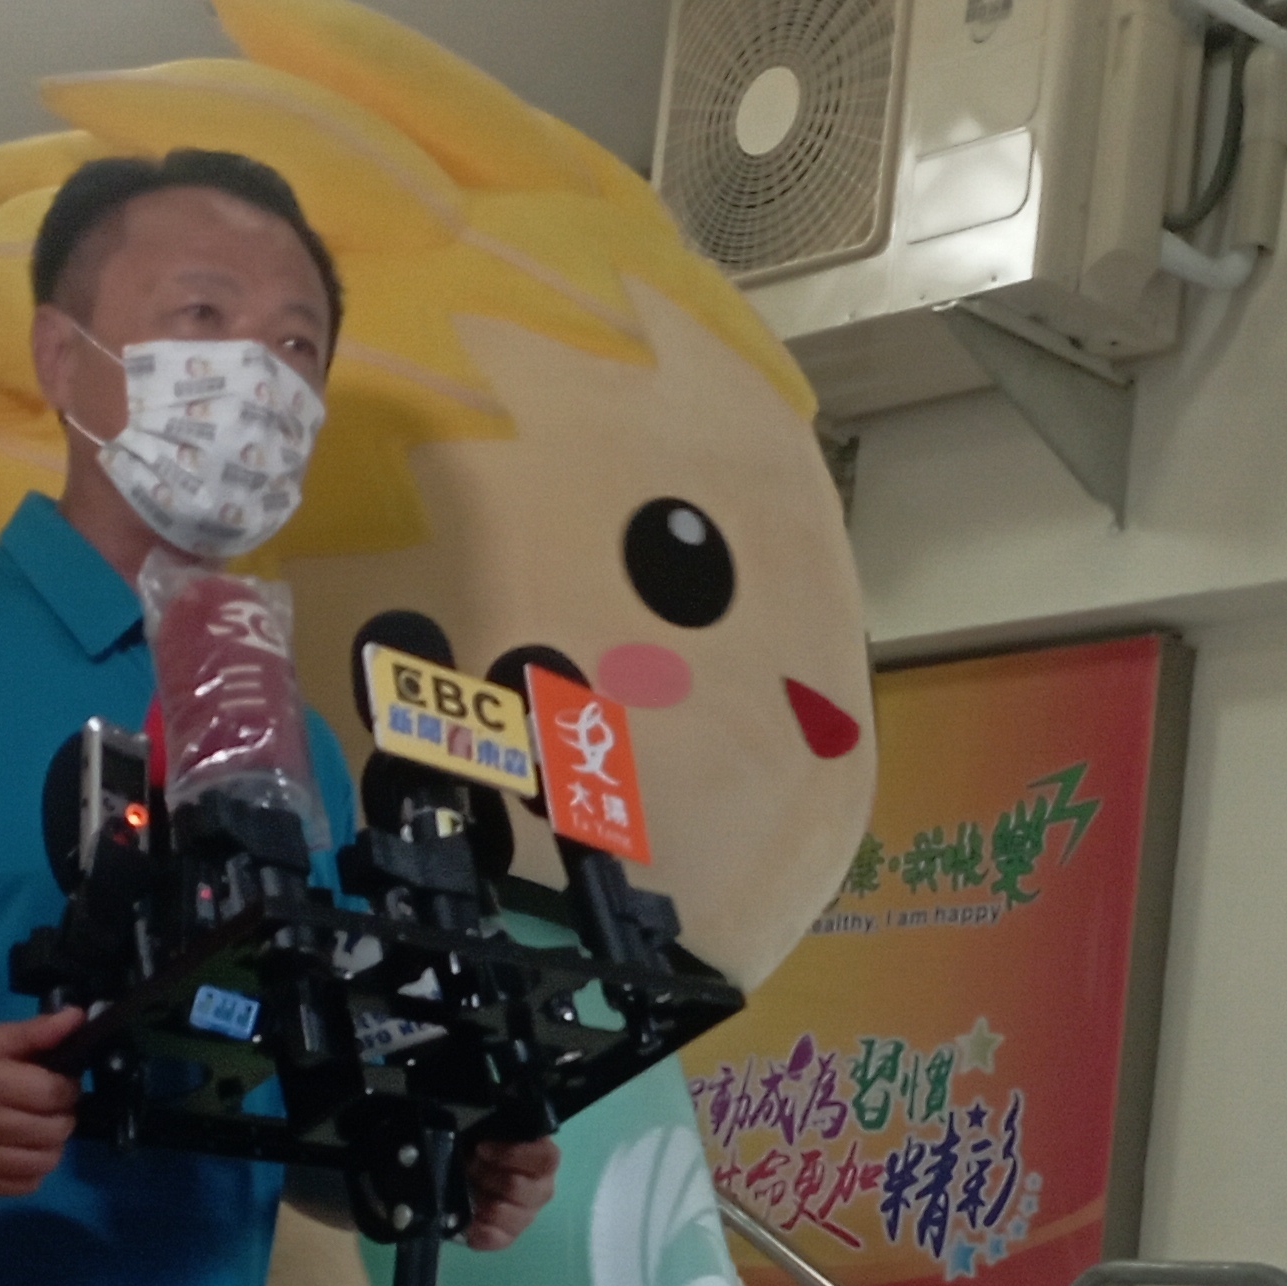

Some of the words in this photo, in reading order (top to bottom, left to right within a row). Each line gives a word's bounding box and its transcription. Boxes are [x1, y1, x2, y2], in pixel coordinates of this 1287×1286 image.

[394, 665, 504, 731] EBC
[811, 914, 877, 932] ealthy,
[898, 910, 927, 926] am
[935, 903, 1002, 925] happy
